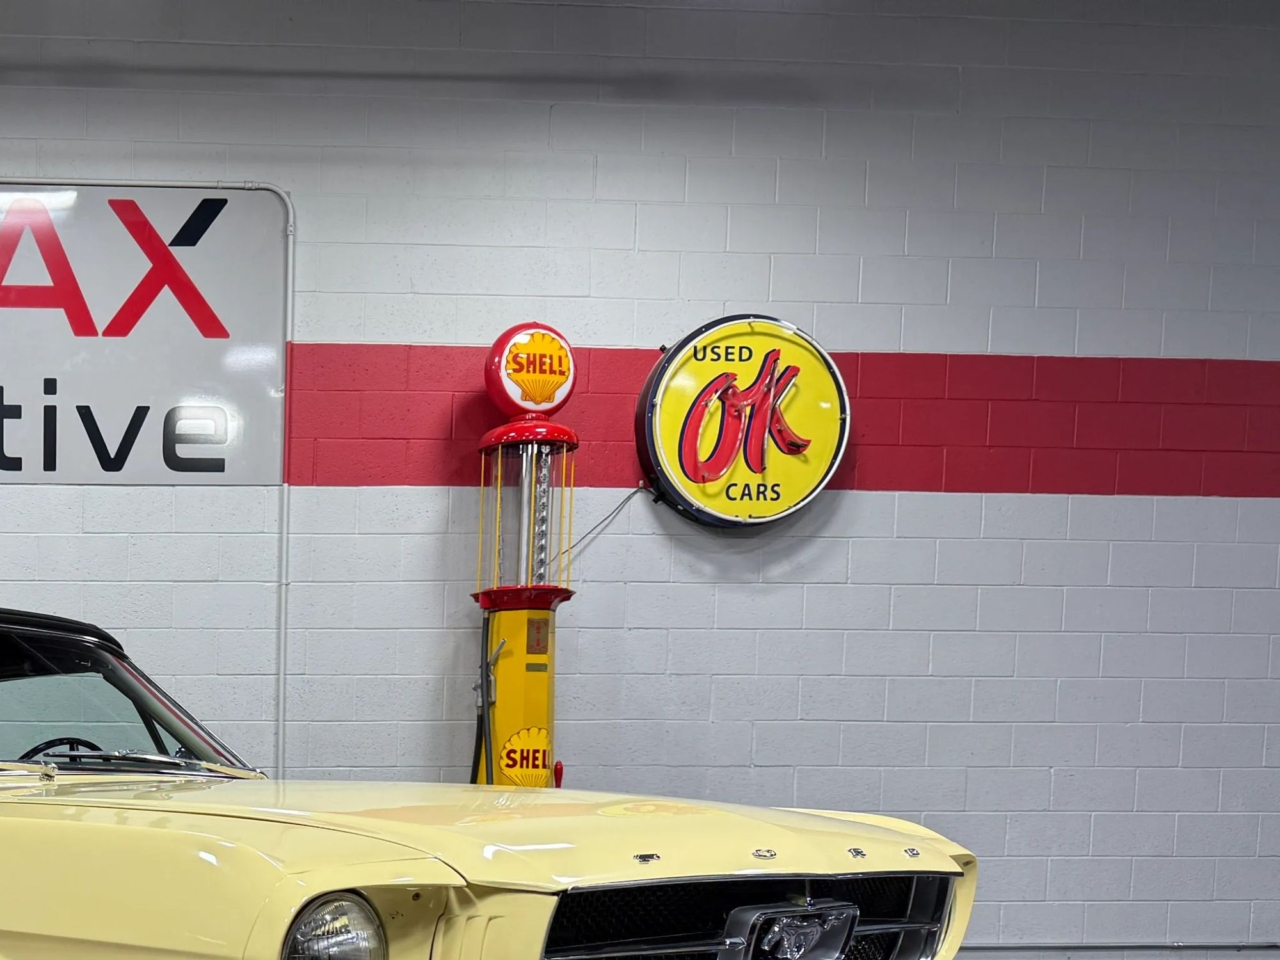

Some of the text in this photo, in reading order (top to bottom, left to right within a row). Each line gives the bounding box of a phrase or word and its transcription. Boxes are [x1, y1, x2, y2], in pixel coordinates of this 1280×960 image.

[693, 346, 753, 362] USED
[512, 353, 566, 376] SHELL
[725, 483, 781, 501] CARS
[633, 848, 920, 864] FORD
